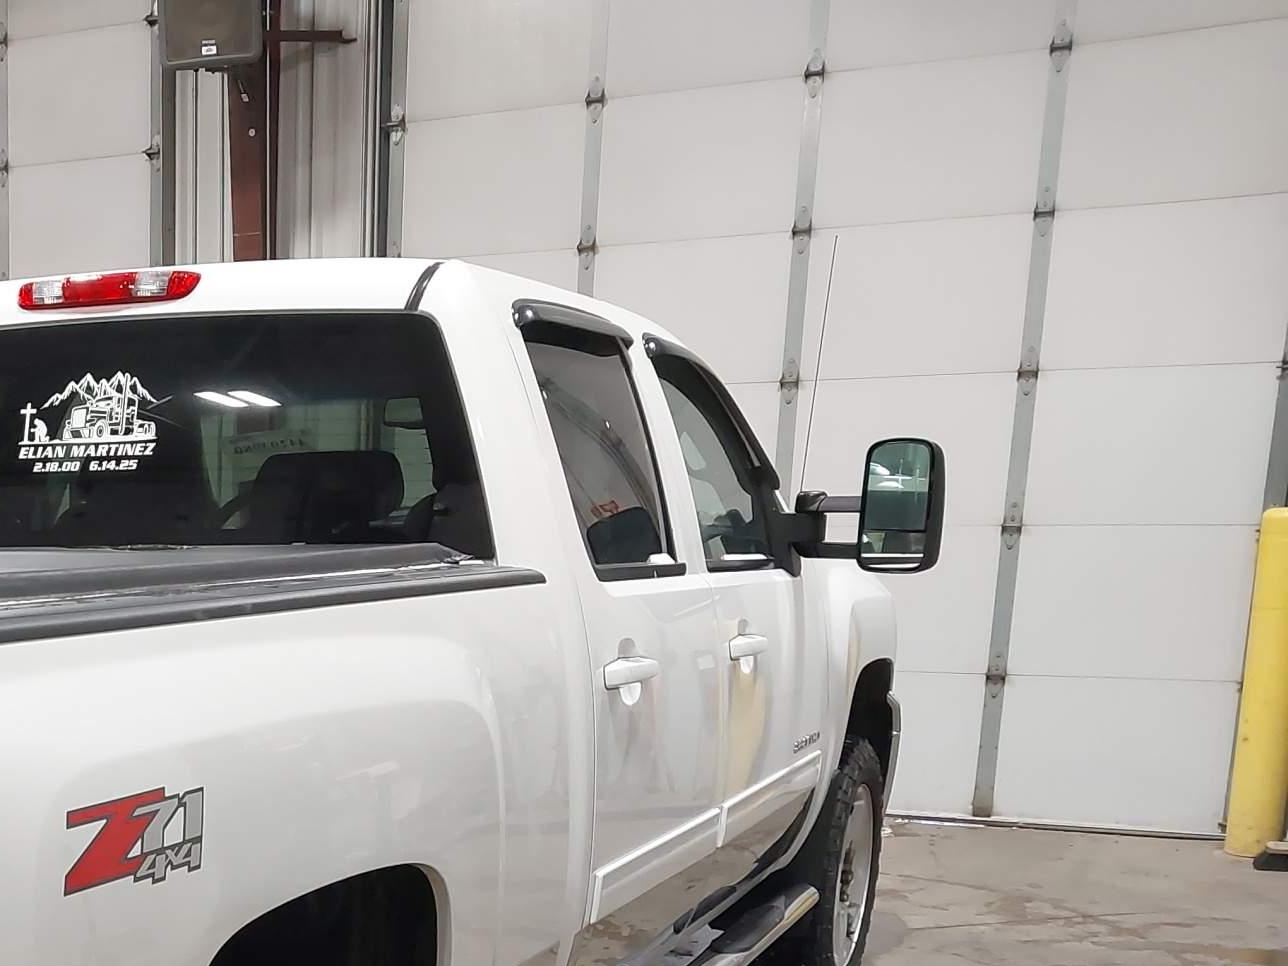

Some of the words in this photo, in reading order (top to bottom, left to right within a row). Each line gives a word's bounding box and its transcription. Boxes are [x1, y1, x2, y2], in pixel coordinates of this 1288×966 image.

[18, 445, 67, 459] ELIAN
[69, 442, 157, 457] MARTINEZ
[32, 461, 81, 473] 2.18.00
[89, 459, 139, 471] 6.14.25
[63, 786, 205, 897] Z71
